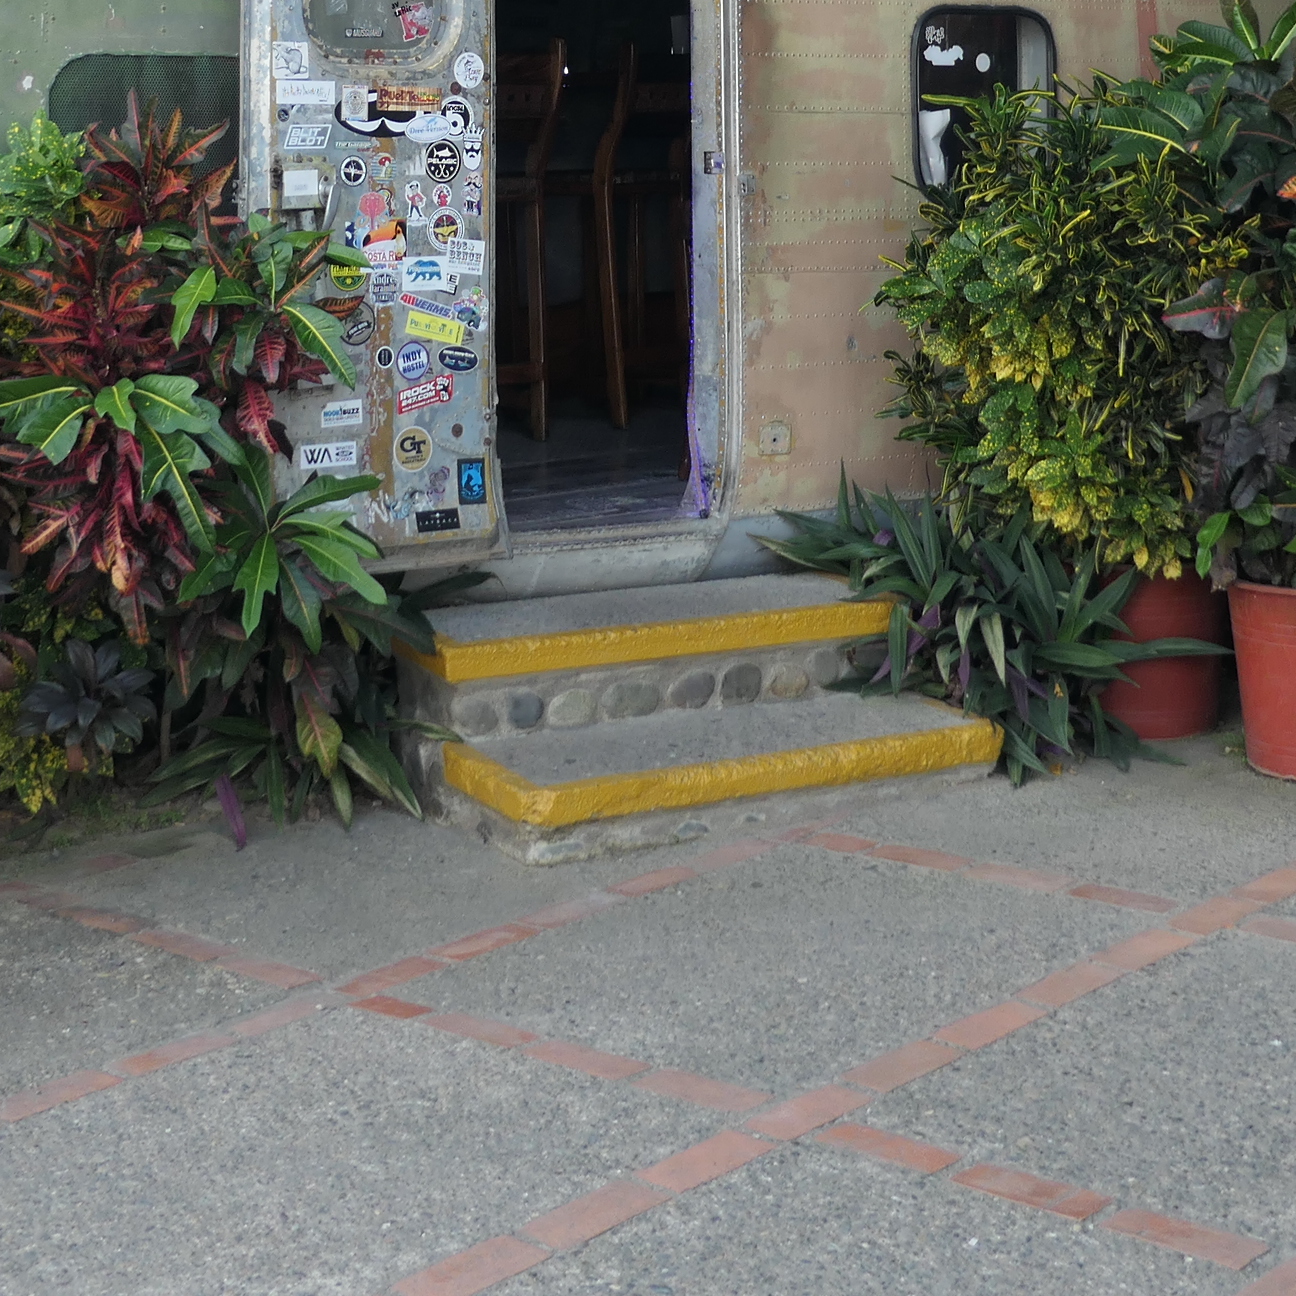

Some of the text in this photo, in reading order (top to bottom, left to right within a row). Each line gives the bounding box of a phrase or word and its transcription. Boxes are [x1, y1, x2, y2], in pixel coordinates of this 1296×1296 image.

[291, 128, 321, 137] BLIT
[288, 136, 324, 146] BLOT
[403, 349, 422, 363] INDY
[402, 362, 425, 373] HOSTEL
[400, 435, 426, 454] GT
